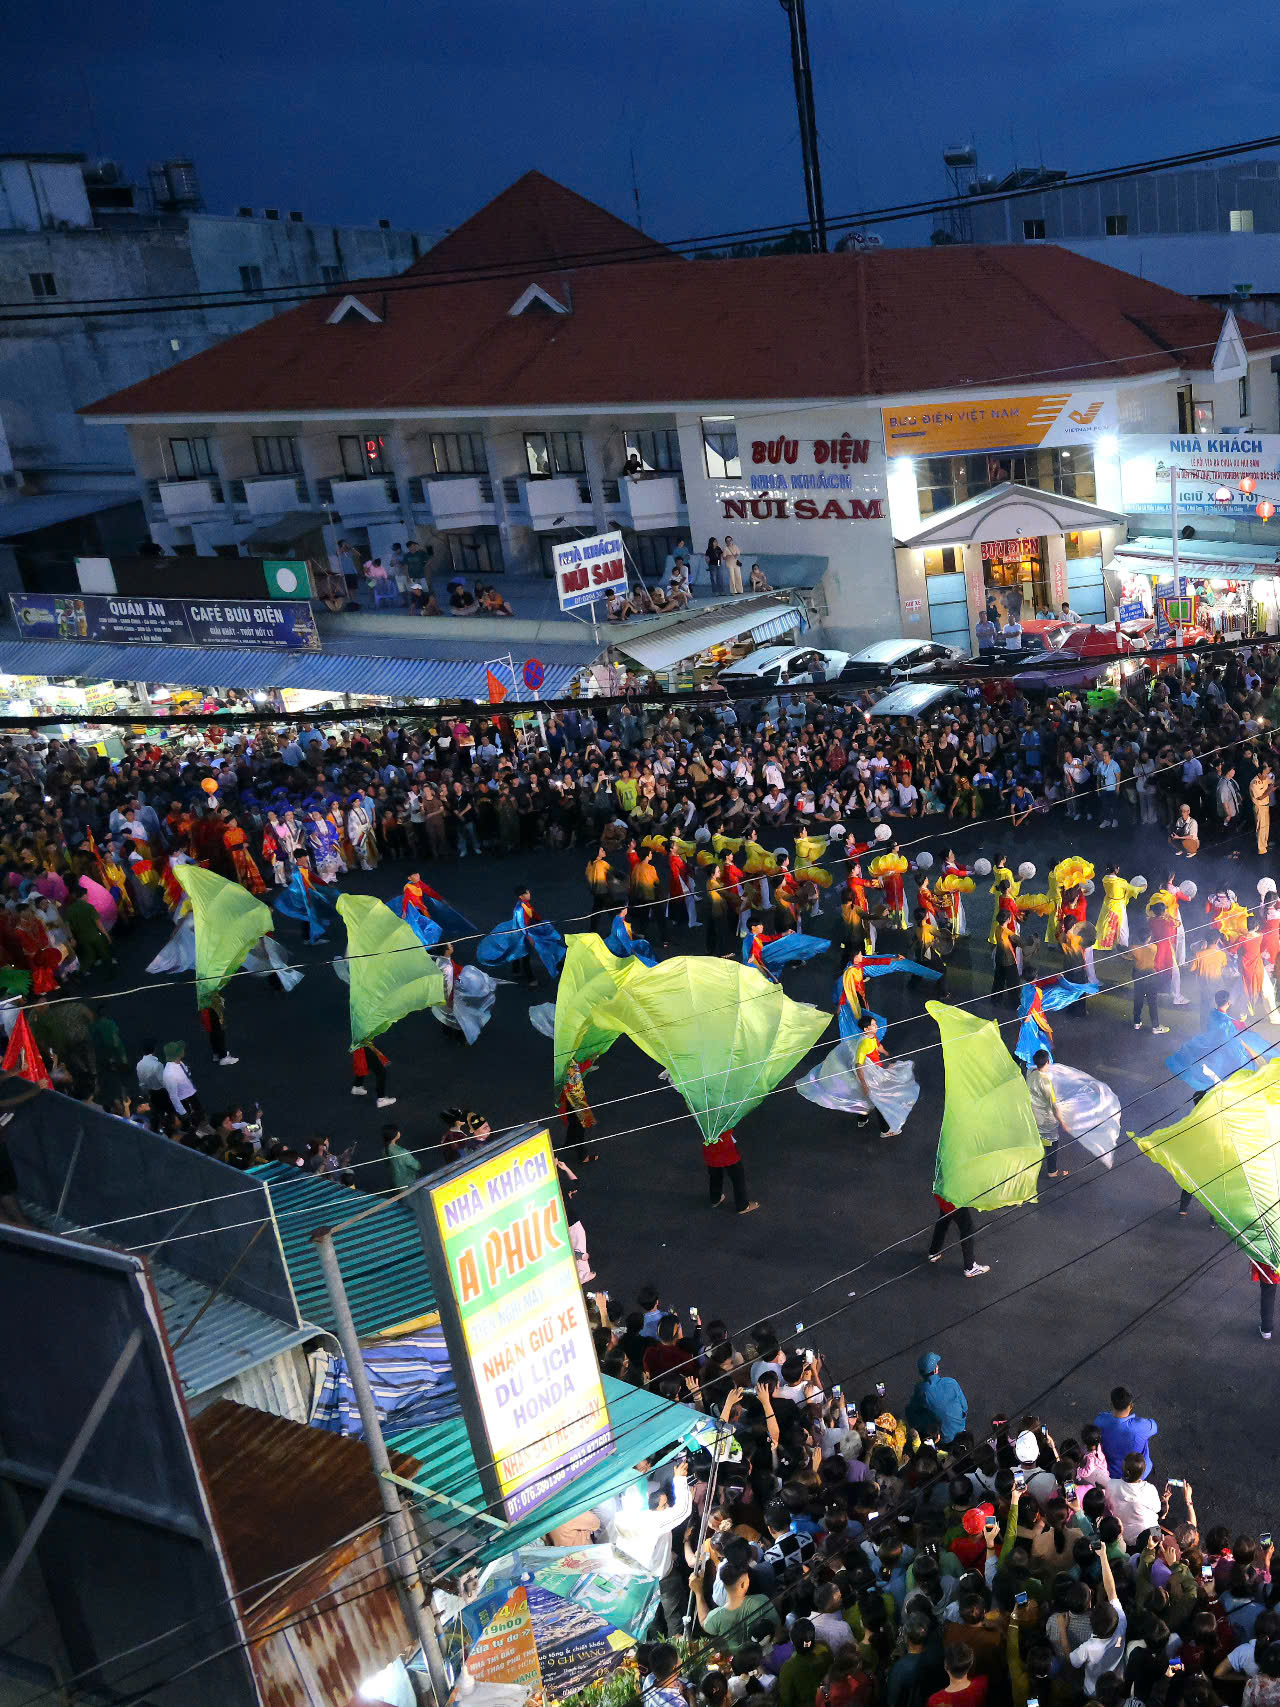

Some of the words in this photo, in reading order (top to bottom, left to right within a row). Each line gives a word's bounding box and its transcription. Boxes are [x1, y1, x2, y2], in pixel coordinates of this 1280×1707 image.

[957, 408, 986, 423] VIỆT
[991, 407, 1020, 419] NAM
[813, 432, 870, 469] ĐIỆN
[1170, 436, 1202, 453] NHÀ
[1207, 436, 1263, 453] KHÁCH
[721, 491, 791, 519] NÚI
[794, 499, 887, 520] SAM
[583, 539, 621, 560] KHÁCH
[562, 563, 590, 593] NÚI
[591, 558, 625, 585] SAM
[109, 600, 145, 616] QUÁN
[147, 601, 166, 617] ĂN
[190, 604, 224, 622] CAFÉ
[253, 605, 285, 626] ĐIỆN
[443, 1184, 484, 1228] NHÀ
[487, 1151, 549, 1204] KHÁCH
[457, 1247, 481, 1303] A
[485, 1198, 562, 1287] PHÚC
[482, 1341, 526, 1383] NHẬN
[529, 1316, 554, 1354] GIỮ
[560, 1307, 578, 1336] XE
[495, 1373, 524, 1409] DU
[533, 1339, 577, 1381] LỊCH
[513, 1373, 576, 1429] HONDA
[492, 1638, 505, 1649] tự
[506, 1633, 520, 1644] do
